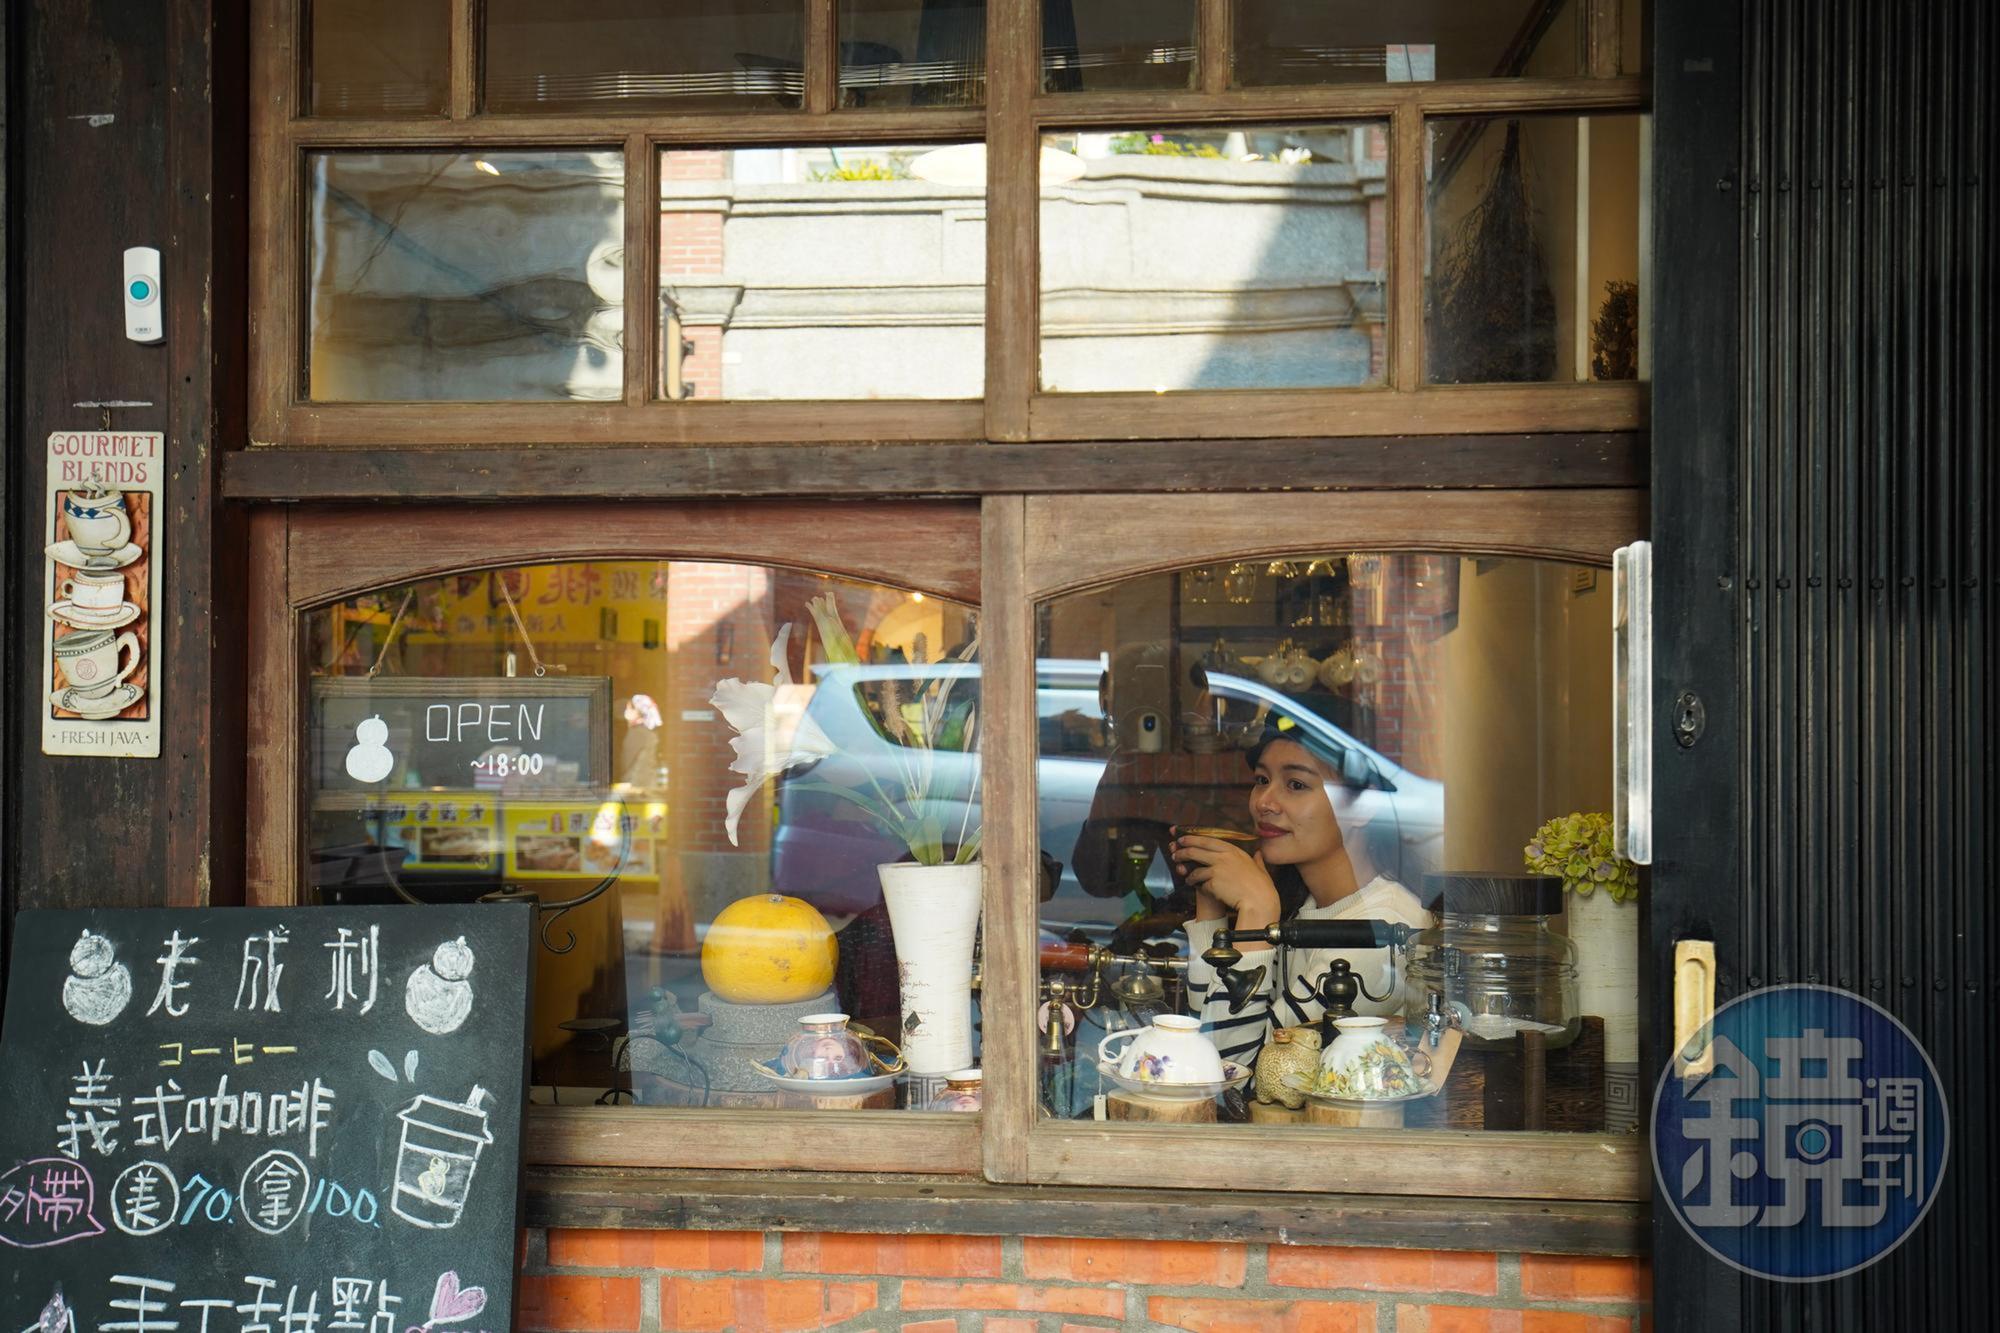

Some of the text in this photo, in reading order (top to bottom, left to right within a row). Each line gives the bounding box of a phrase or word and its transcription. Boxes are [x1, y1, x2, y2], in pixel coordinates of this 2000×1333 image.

[52, 434, 159, 457] GOURMET
[62, 460, 148, 484] BLENDS
[61, 730, 143, 746] FRESH JAVA
[426, 703, 544, 742] OPEN
[146, 924, 380, 1016] 老成利
[57, 1058, 336, 1160] 義式咖啡
